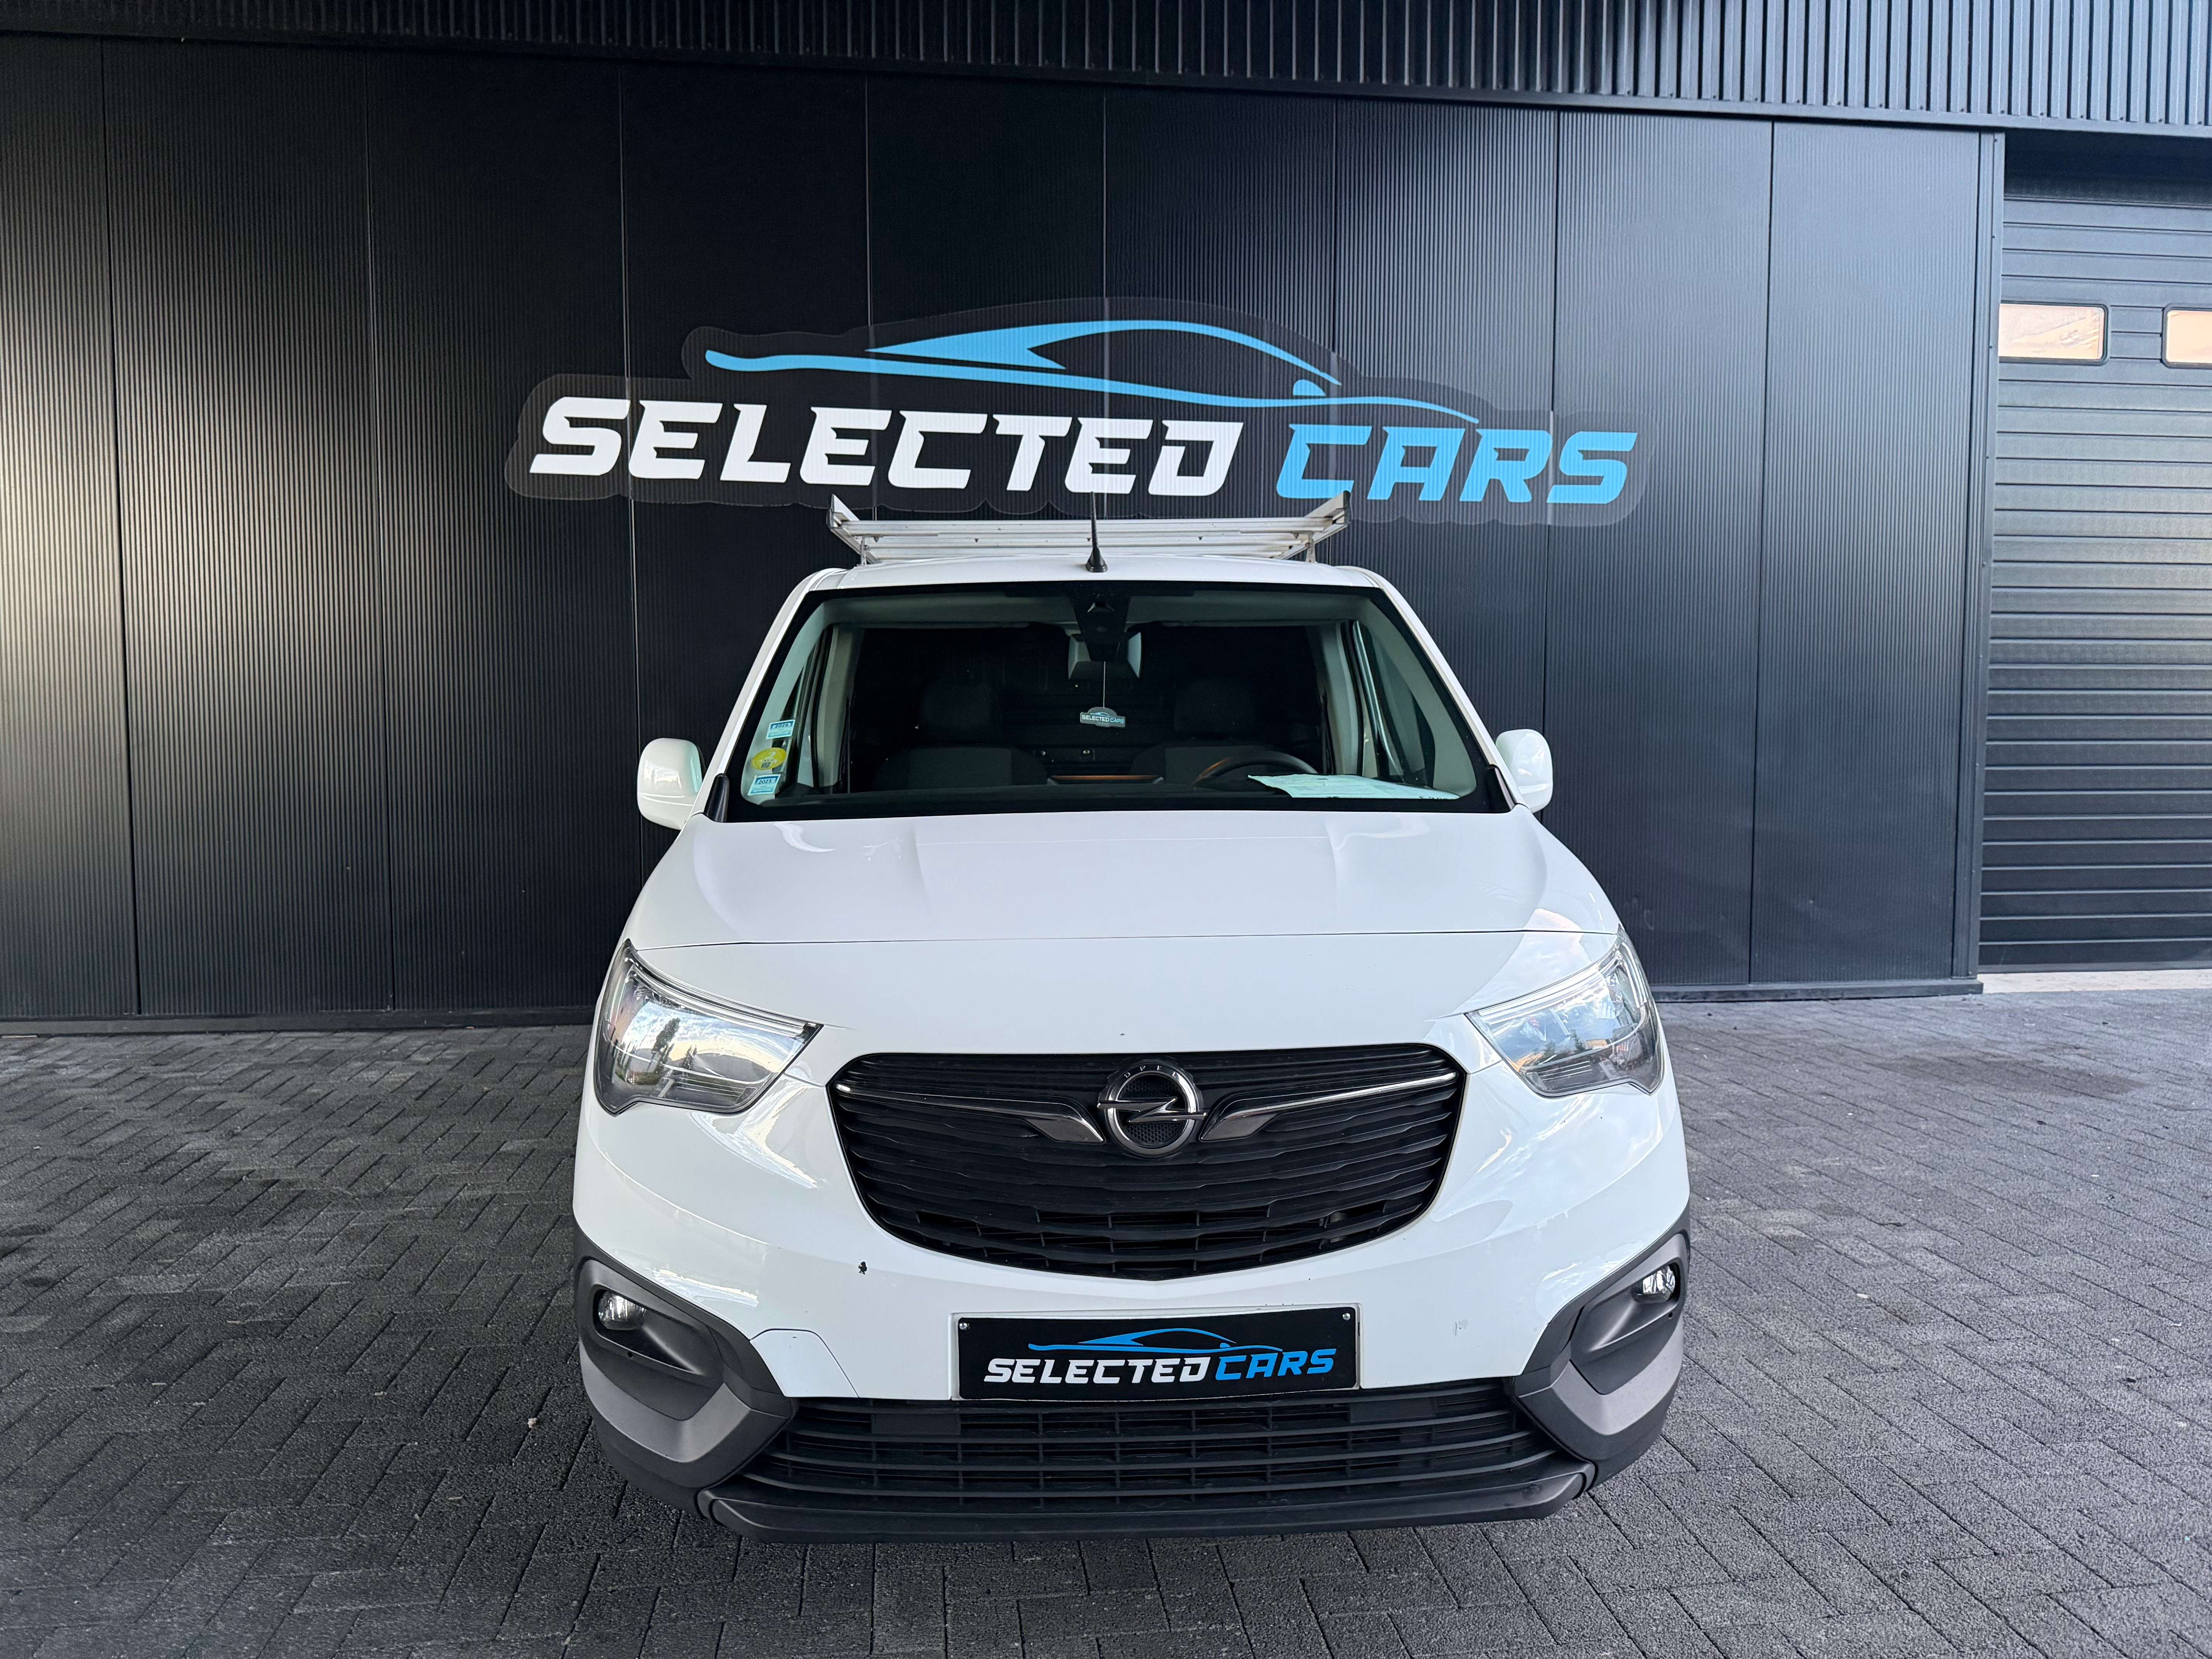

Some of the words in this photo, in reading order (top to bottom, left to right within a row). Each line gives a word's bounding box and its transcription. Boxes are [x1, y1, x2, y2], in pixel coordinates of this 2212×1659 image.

[529, 396, 1244, 496] SELECTED
[1276, 423, 1638, 505] CARS
[1124, 1065, 1178, 1079] OPEL
[984, 1357, 1211, 1384] SELECTED
[1215, 1348, 1336, 1380] CARS
